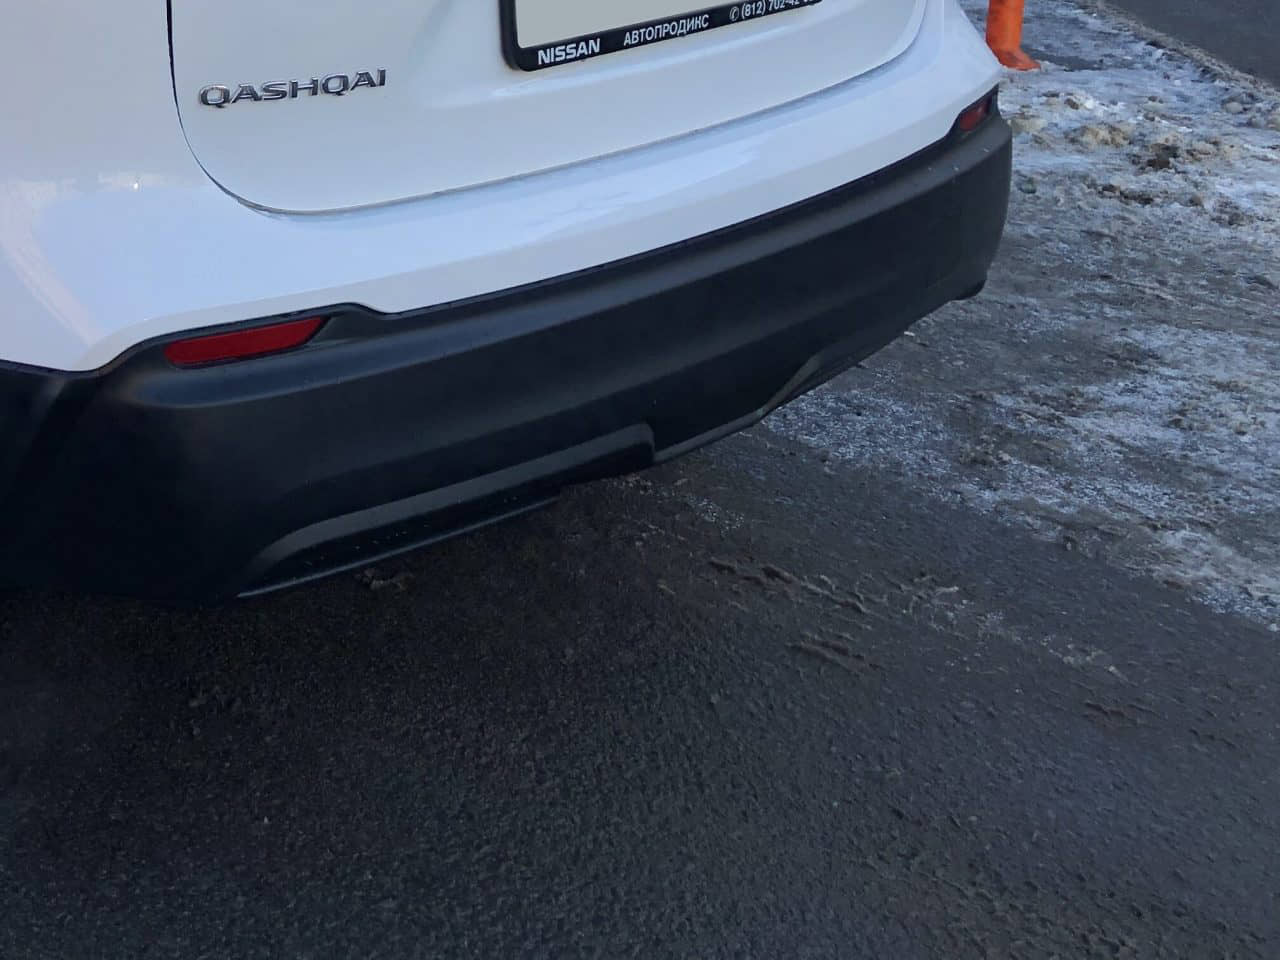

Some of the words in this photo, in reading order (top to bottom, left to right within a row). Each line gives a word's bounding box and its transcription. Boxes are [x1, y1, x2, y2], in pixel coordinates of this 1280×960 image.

[537, 38, 601, 65] NISSAN
[623, 13, 710, 46] АВТОПРОДИКС
[741, 0, 767, 19] (812)
[200, 67, 387, 108] QASHQAI
